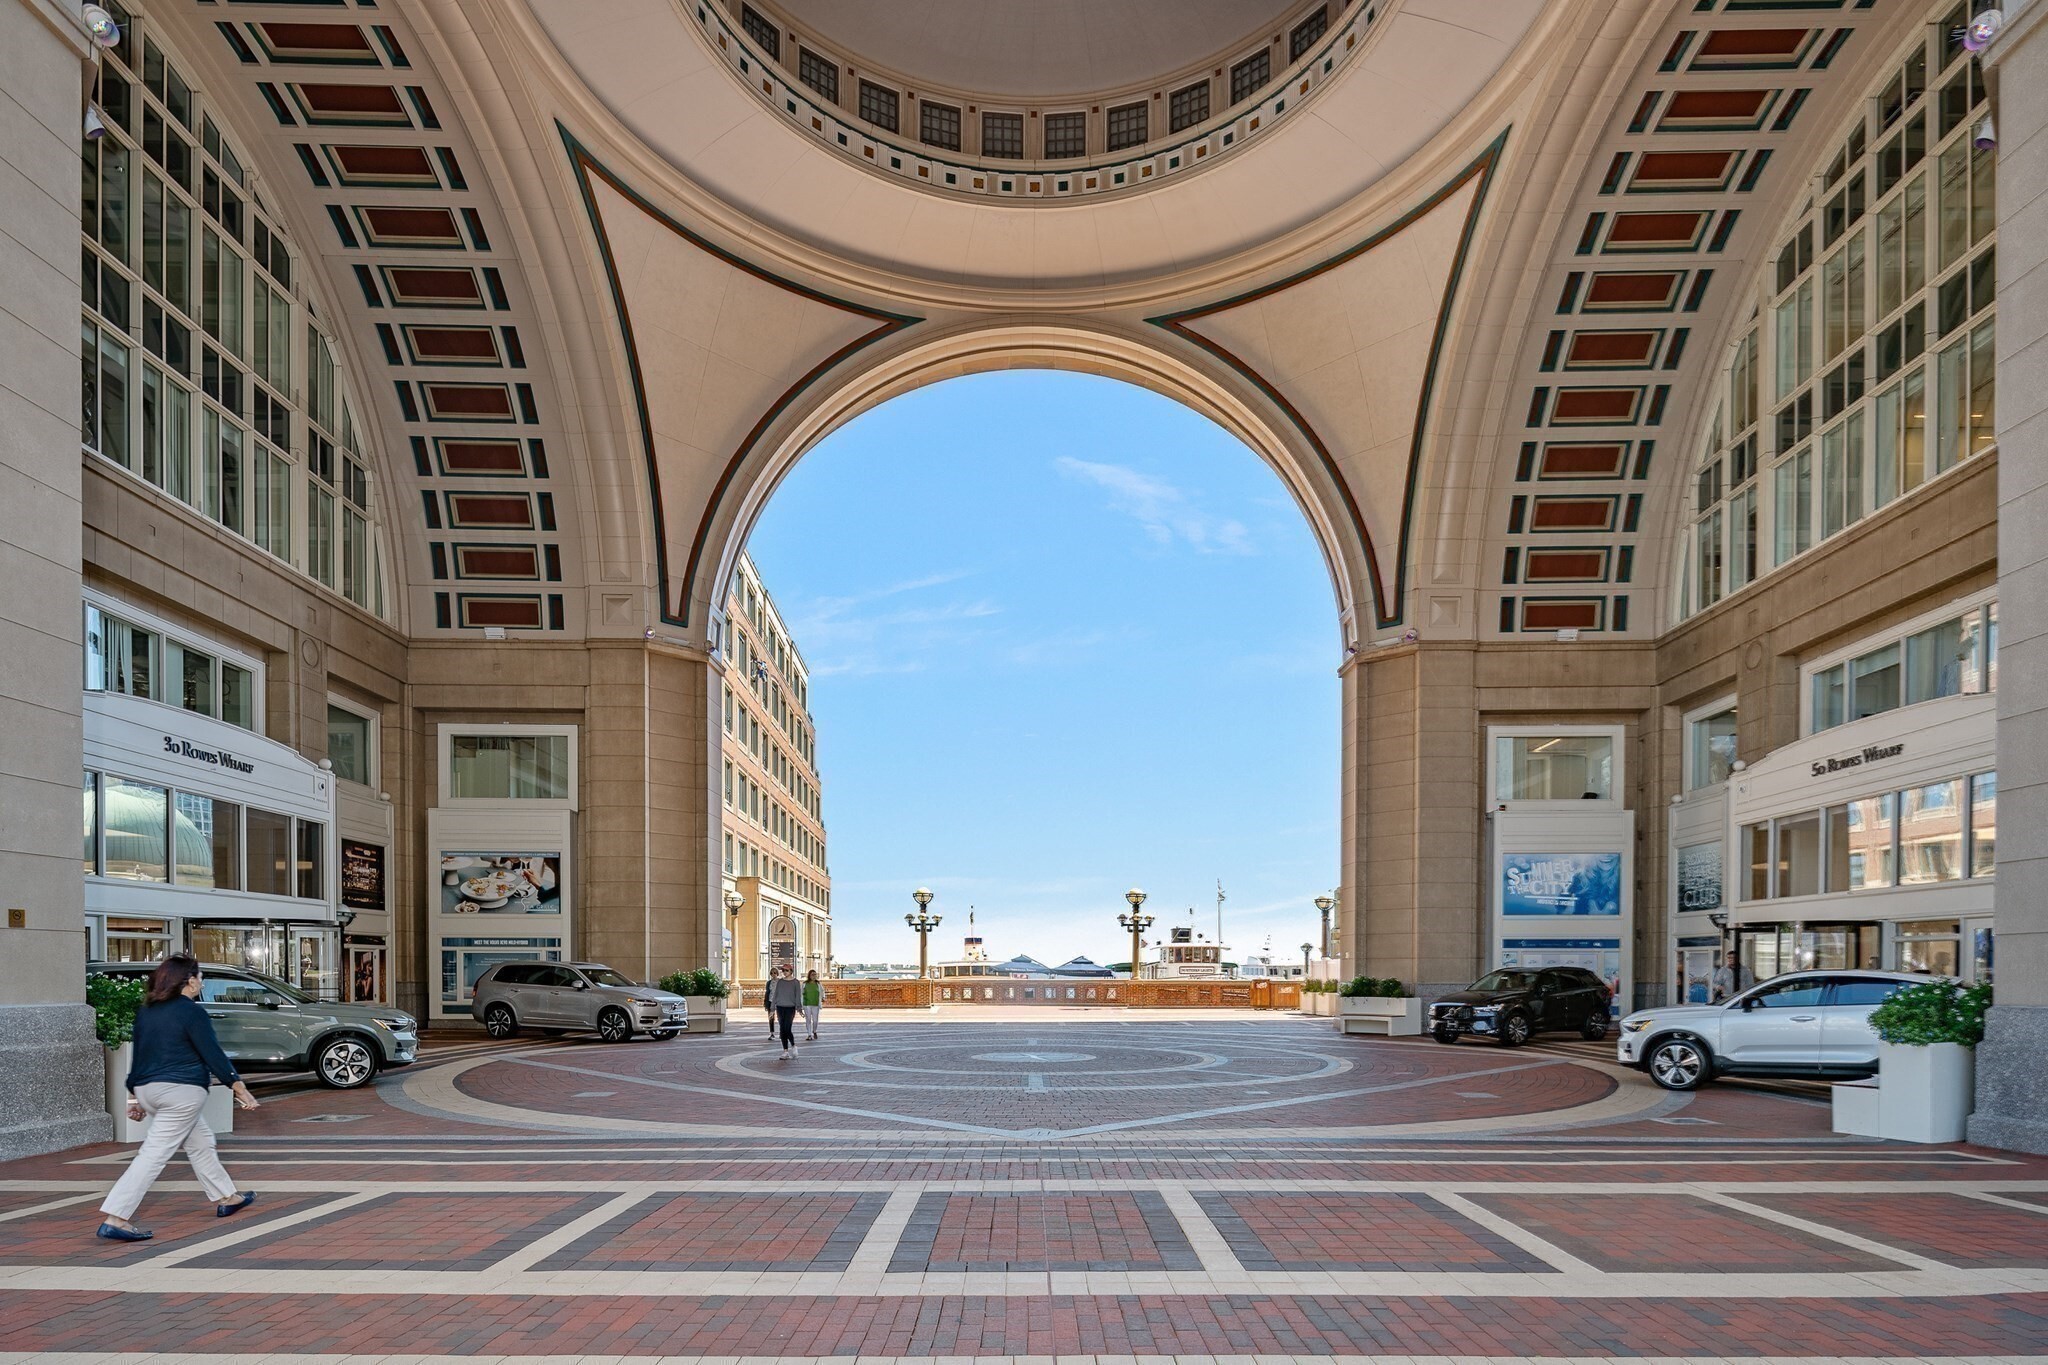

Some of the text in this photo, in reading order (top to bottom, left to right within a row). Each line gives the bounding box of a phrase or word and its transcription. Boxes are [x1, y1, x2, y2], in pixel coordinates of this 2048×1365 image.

[164, 736, 254, 773] 30 ROWES WHARF
[1811, 743, 1904, 777] 50 ROWES WHARF
[1530, 880, 1573, 895] CITY
[1684, 888, 1717, 907] CLUB
